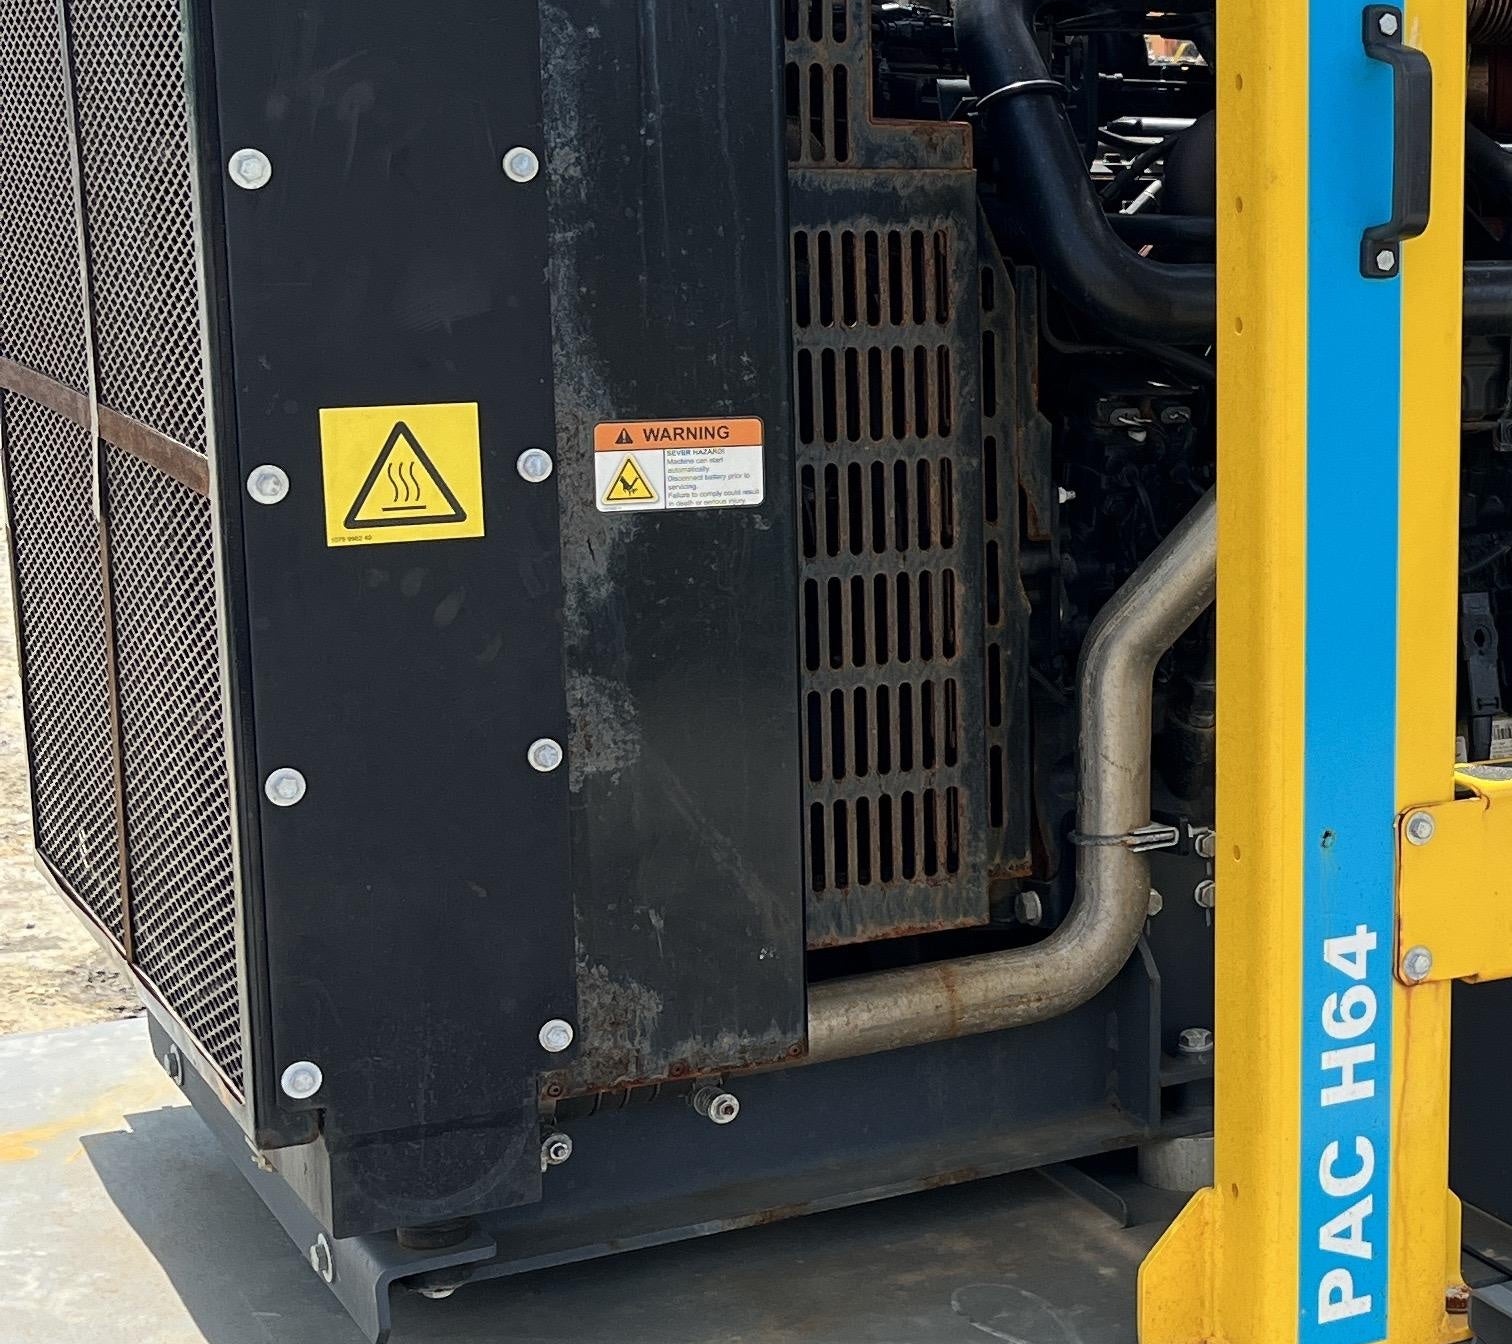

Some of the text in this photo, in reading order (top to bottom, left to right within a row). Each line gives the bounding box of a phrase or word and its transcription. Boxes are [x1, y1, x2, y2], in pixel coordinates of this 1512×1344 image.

[643, 425, 730, 442] WARNING
[668, 491, 690, 499] Failure
[699, 490, 722, 498] comply
[1317, 924, 1377, 1325] PAC H64
